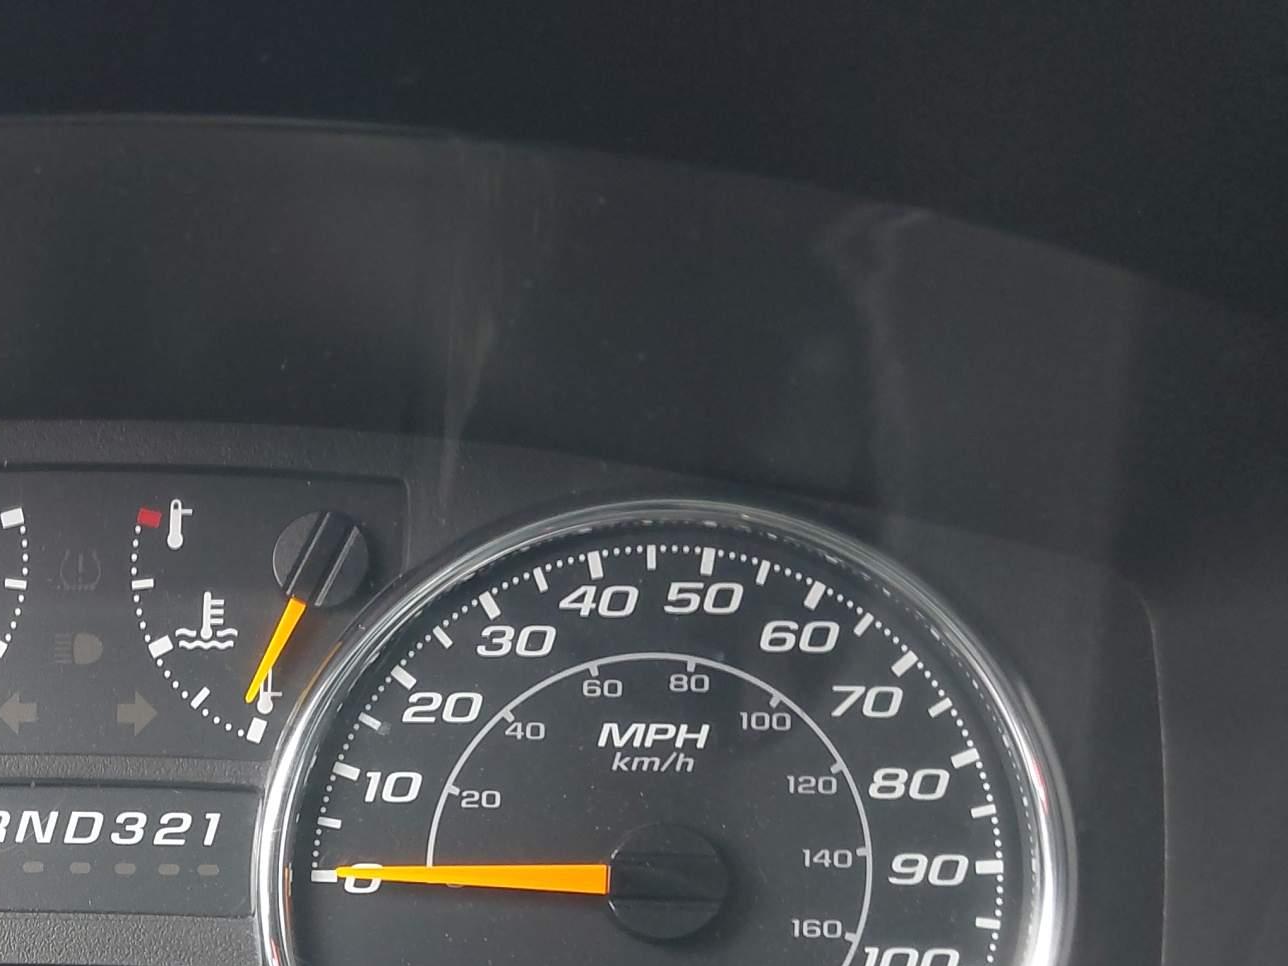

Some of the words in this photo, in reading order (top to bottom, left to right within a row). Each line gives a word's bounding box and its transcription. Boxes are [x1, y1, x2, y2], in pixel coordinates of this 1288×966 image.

[559, 585, 640, 618] 40
[663, 582, 744, 614] 50
[476, 625, 557, 658] 30
[760, 620, 840, 653] 60
[582, 679, 623, 698] 60
[669, 674, 710, 693] 80
[402, 691, 483, 723] 20
[831, 685, 903, 718] 70
[504, 721, 546, 740] 40
[740, 711, 792, 731] 100
[598, 723, 710, 749] MPH
[611, 751, 695, 773] km/h
[364, 771, 423, 803] 10
[787, 775, 837, 795] 120
[868, 768, 950, 800] 80
[461, 790, 501, 809] 20
[802, 849, 852, 868] 140
[888, 853, 969, 886] 90
[792, 919, 843, 939] 160
